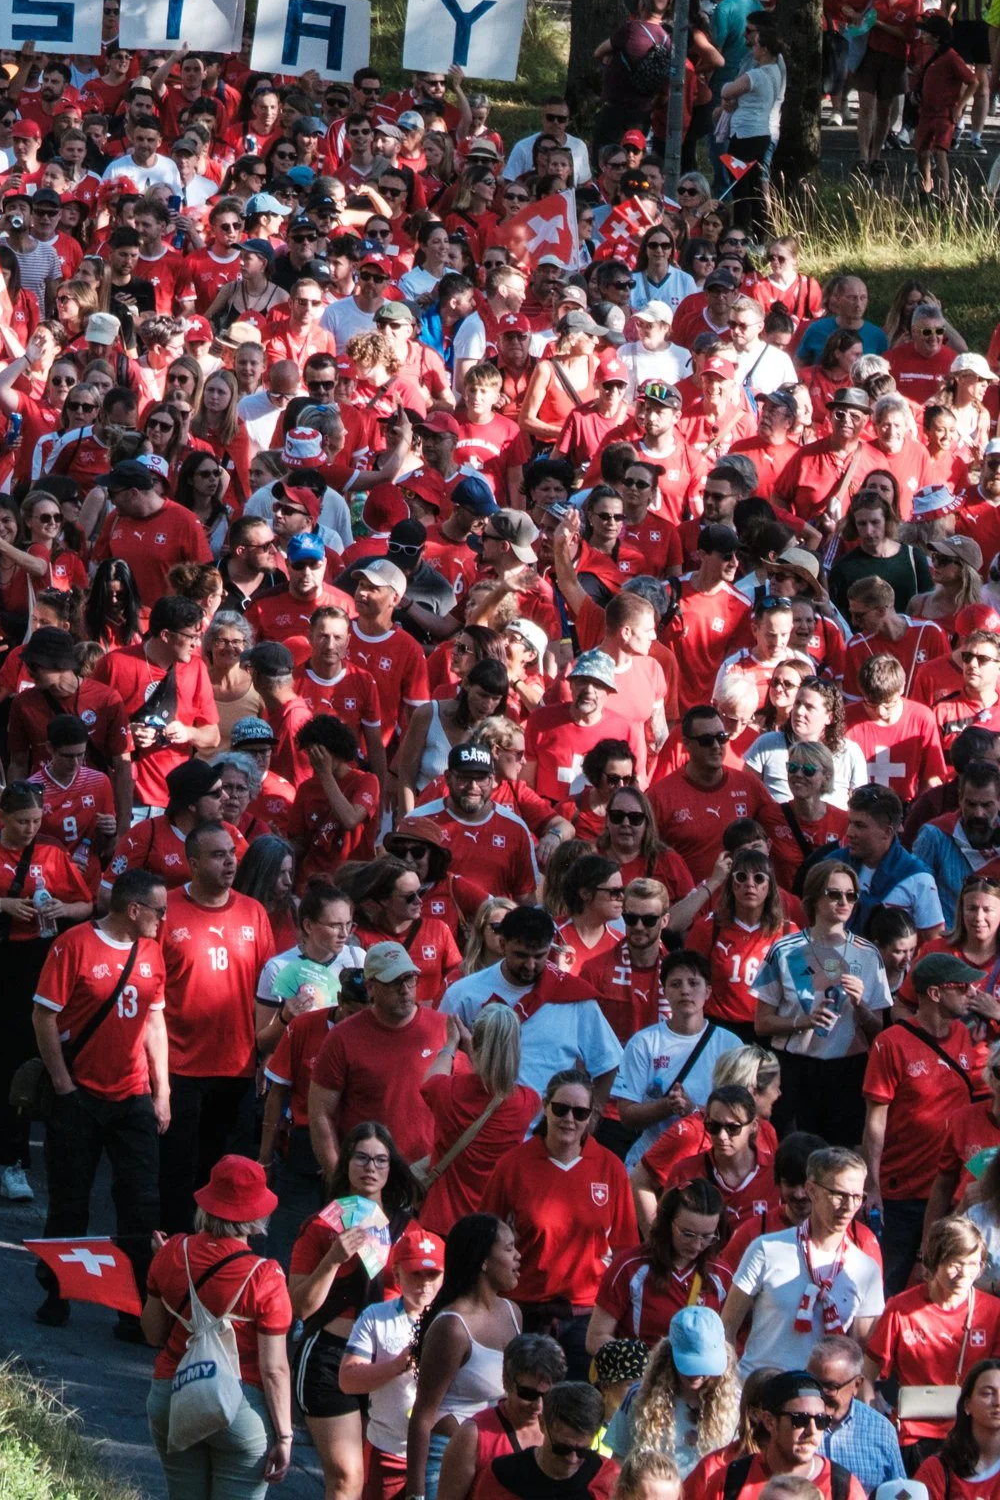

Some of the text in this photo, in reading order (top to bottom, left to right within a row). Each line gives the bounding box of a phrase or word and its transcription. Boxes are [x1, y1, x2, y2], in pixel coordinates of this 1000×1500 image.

[460, 747, 491, 765] BÄRN
[63, 816, 78, 842] 9
[208, 947, 228, 971] 18
[730, 953, 759, 987] 16
[117, 985, 138, 1019] 13
